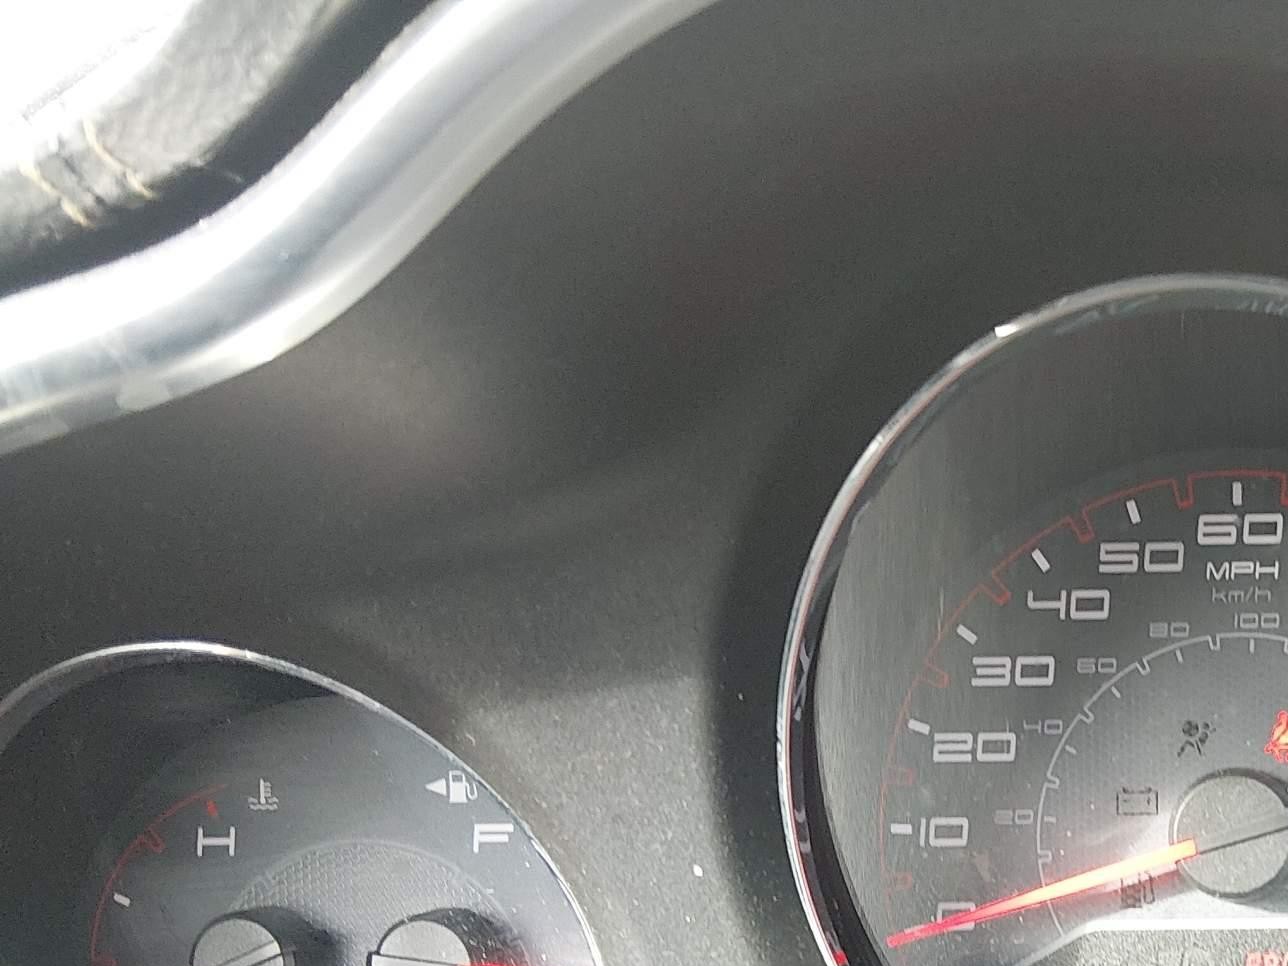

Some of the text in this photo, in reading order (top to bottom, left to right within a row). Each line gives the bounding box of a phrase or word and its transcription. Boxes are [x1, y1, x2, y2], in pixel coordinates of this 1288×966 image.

[1197, 512, 1284, 545] 60
[1098, 541, 1185, 574] 50
[1205, 560, 1280, 582] MPH
[1026, 588, 1111, 621] 40
[1211, 586, 1273, 604] km/h
[1233, 612, 1281, 629] 100
[970, 655, 1056, 688] 30
[1023, 718, 1064, 736] 40
[932, 731, 1017, 763] 20
[196, 825, 236, 857] H
[472, 822, 515, 853] F
[919, 816, 970, 848] 10
